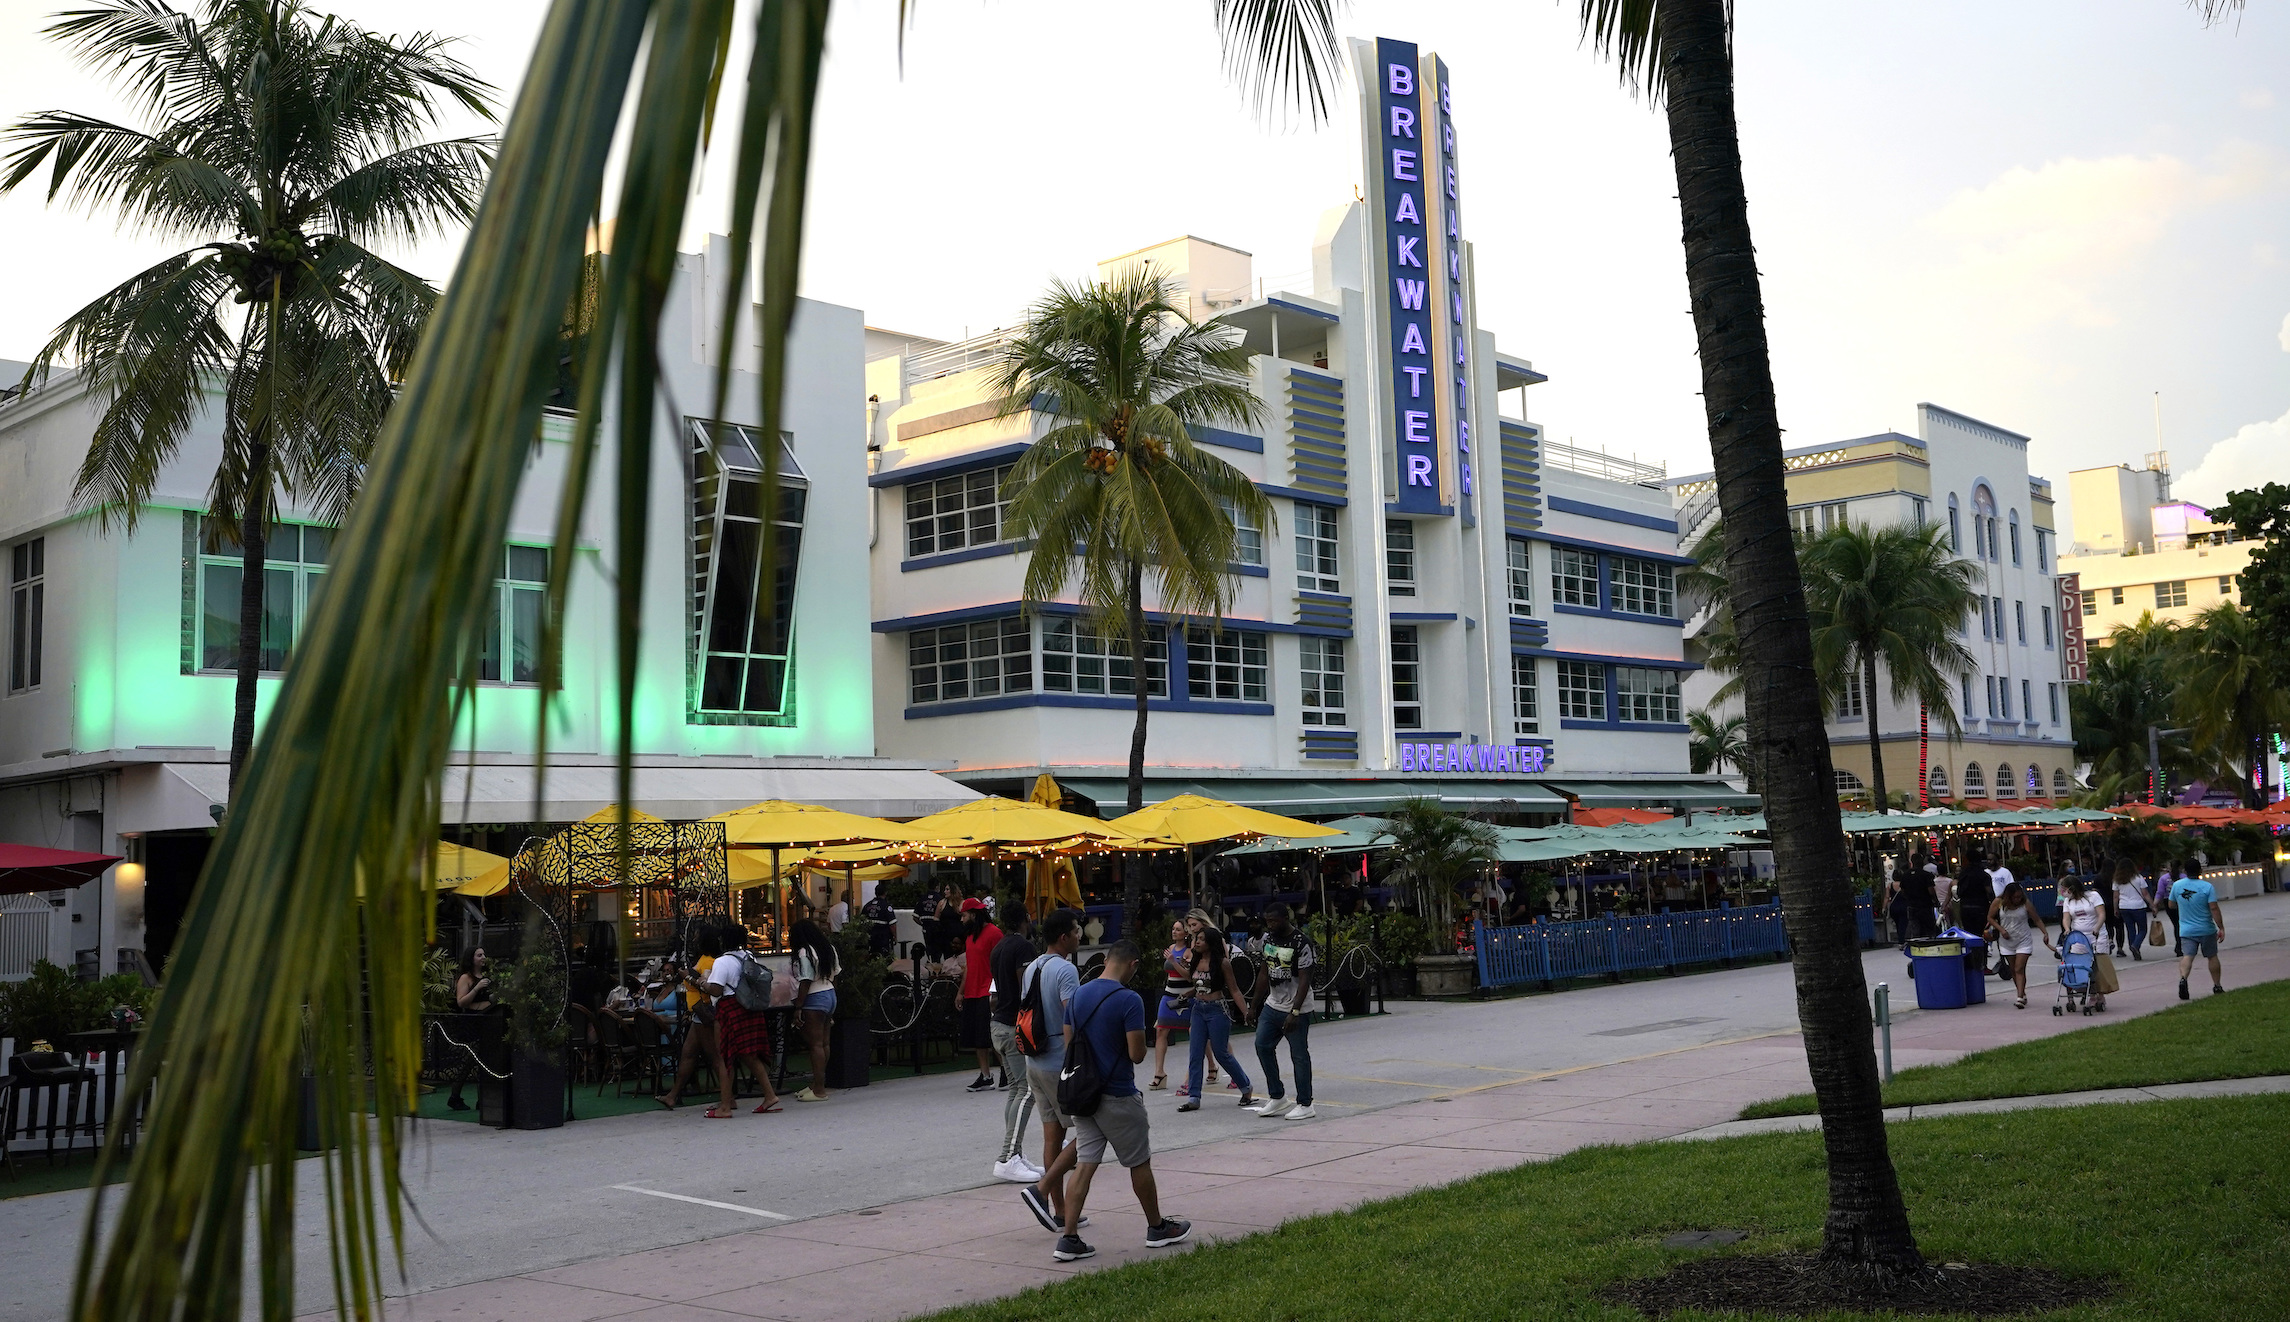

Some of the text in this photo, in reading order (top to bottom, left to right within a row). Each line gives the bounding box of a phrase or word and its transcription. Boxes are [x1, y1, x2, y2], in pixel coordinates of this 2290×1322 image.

[1388, 62, 1432, 488] BREAKWATER
[1440, 81, 1472, 497] BREAKWATER
[1401, 743, 1545, 773] BREAKWATER
[2061, 576, 2080, 681] EDISON
